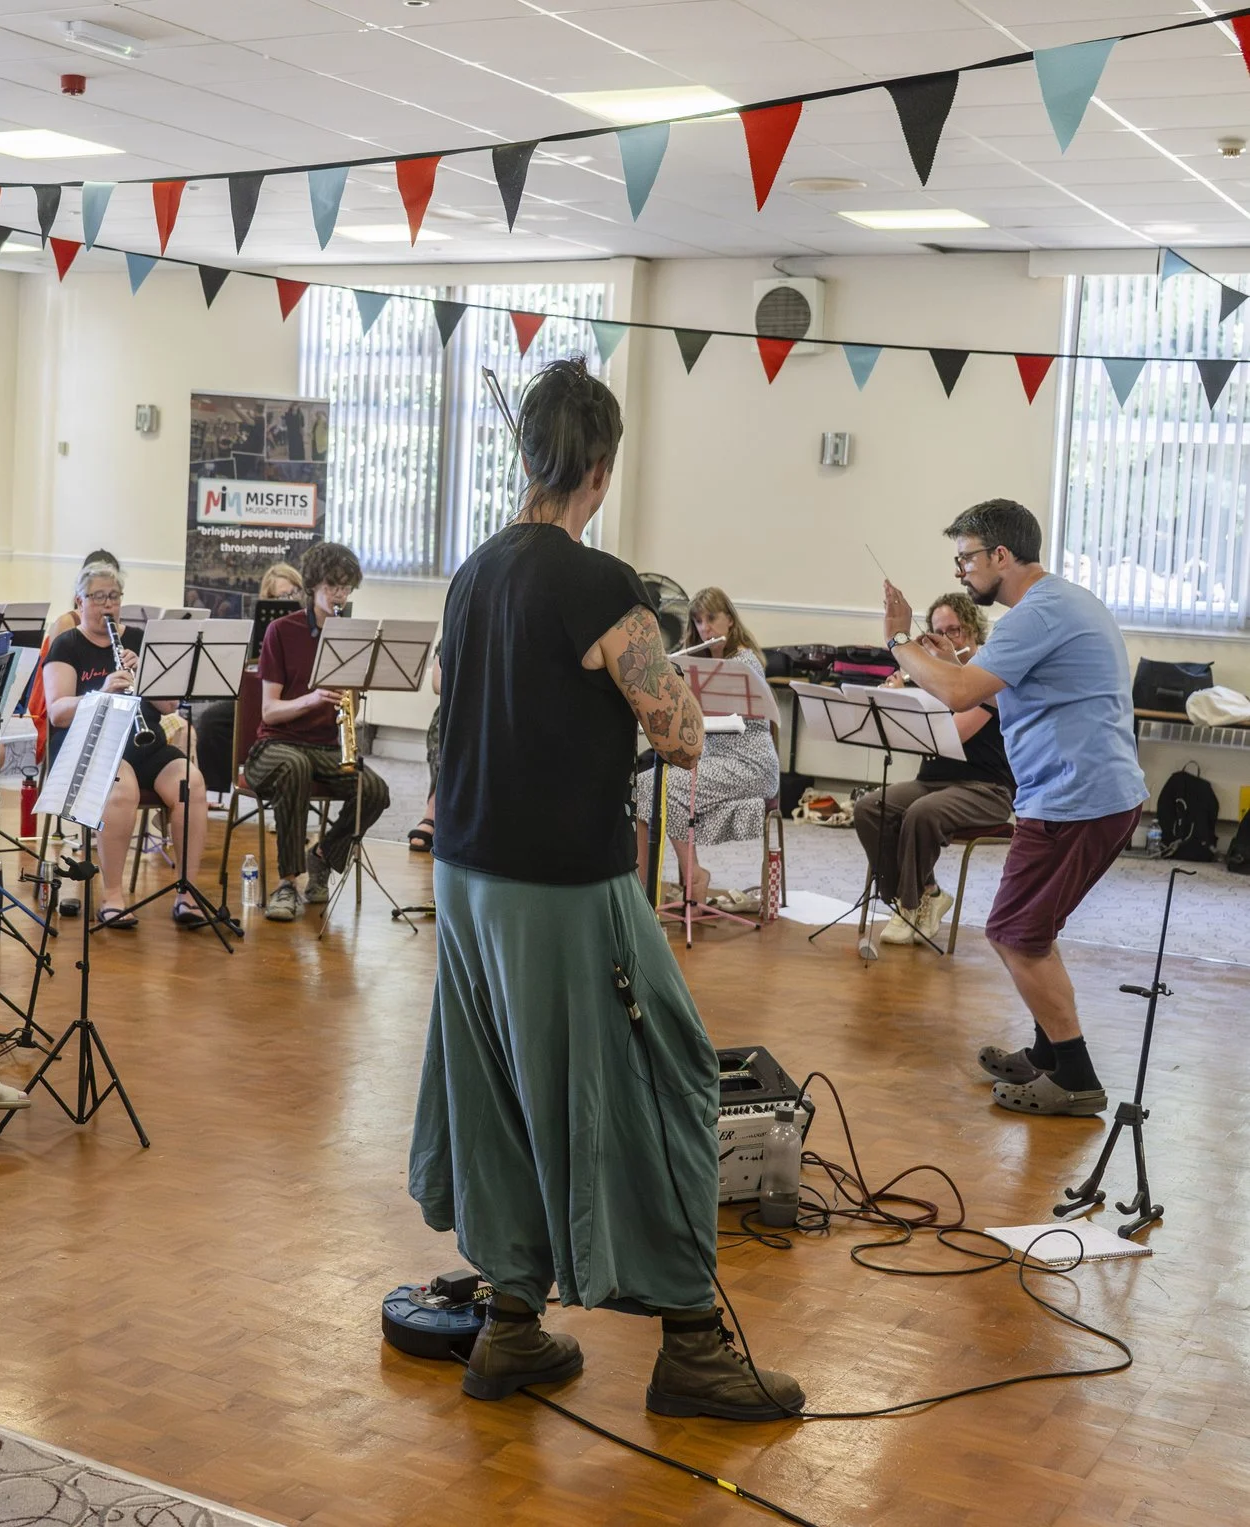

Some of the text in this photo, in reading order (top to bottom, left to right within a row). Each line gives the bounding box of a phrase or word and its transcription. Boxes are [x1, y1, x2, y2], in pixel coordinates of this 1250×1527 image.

[246, 492, 308, 507] MISFITS
[245, 506, 308, 517] MUSIC INSTITUTE
[241, 528, 273, 540] people
[274, 529, 314, 540] together
[220, 543, 258, 554] through
